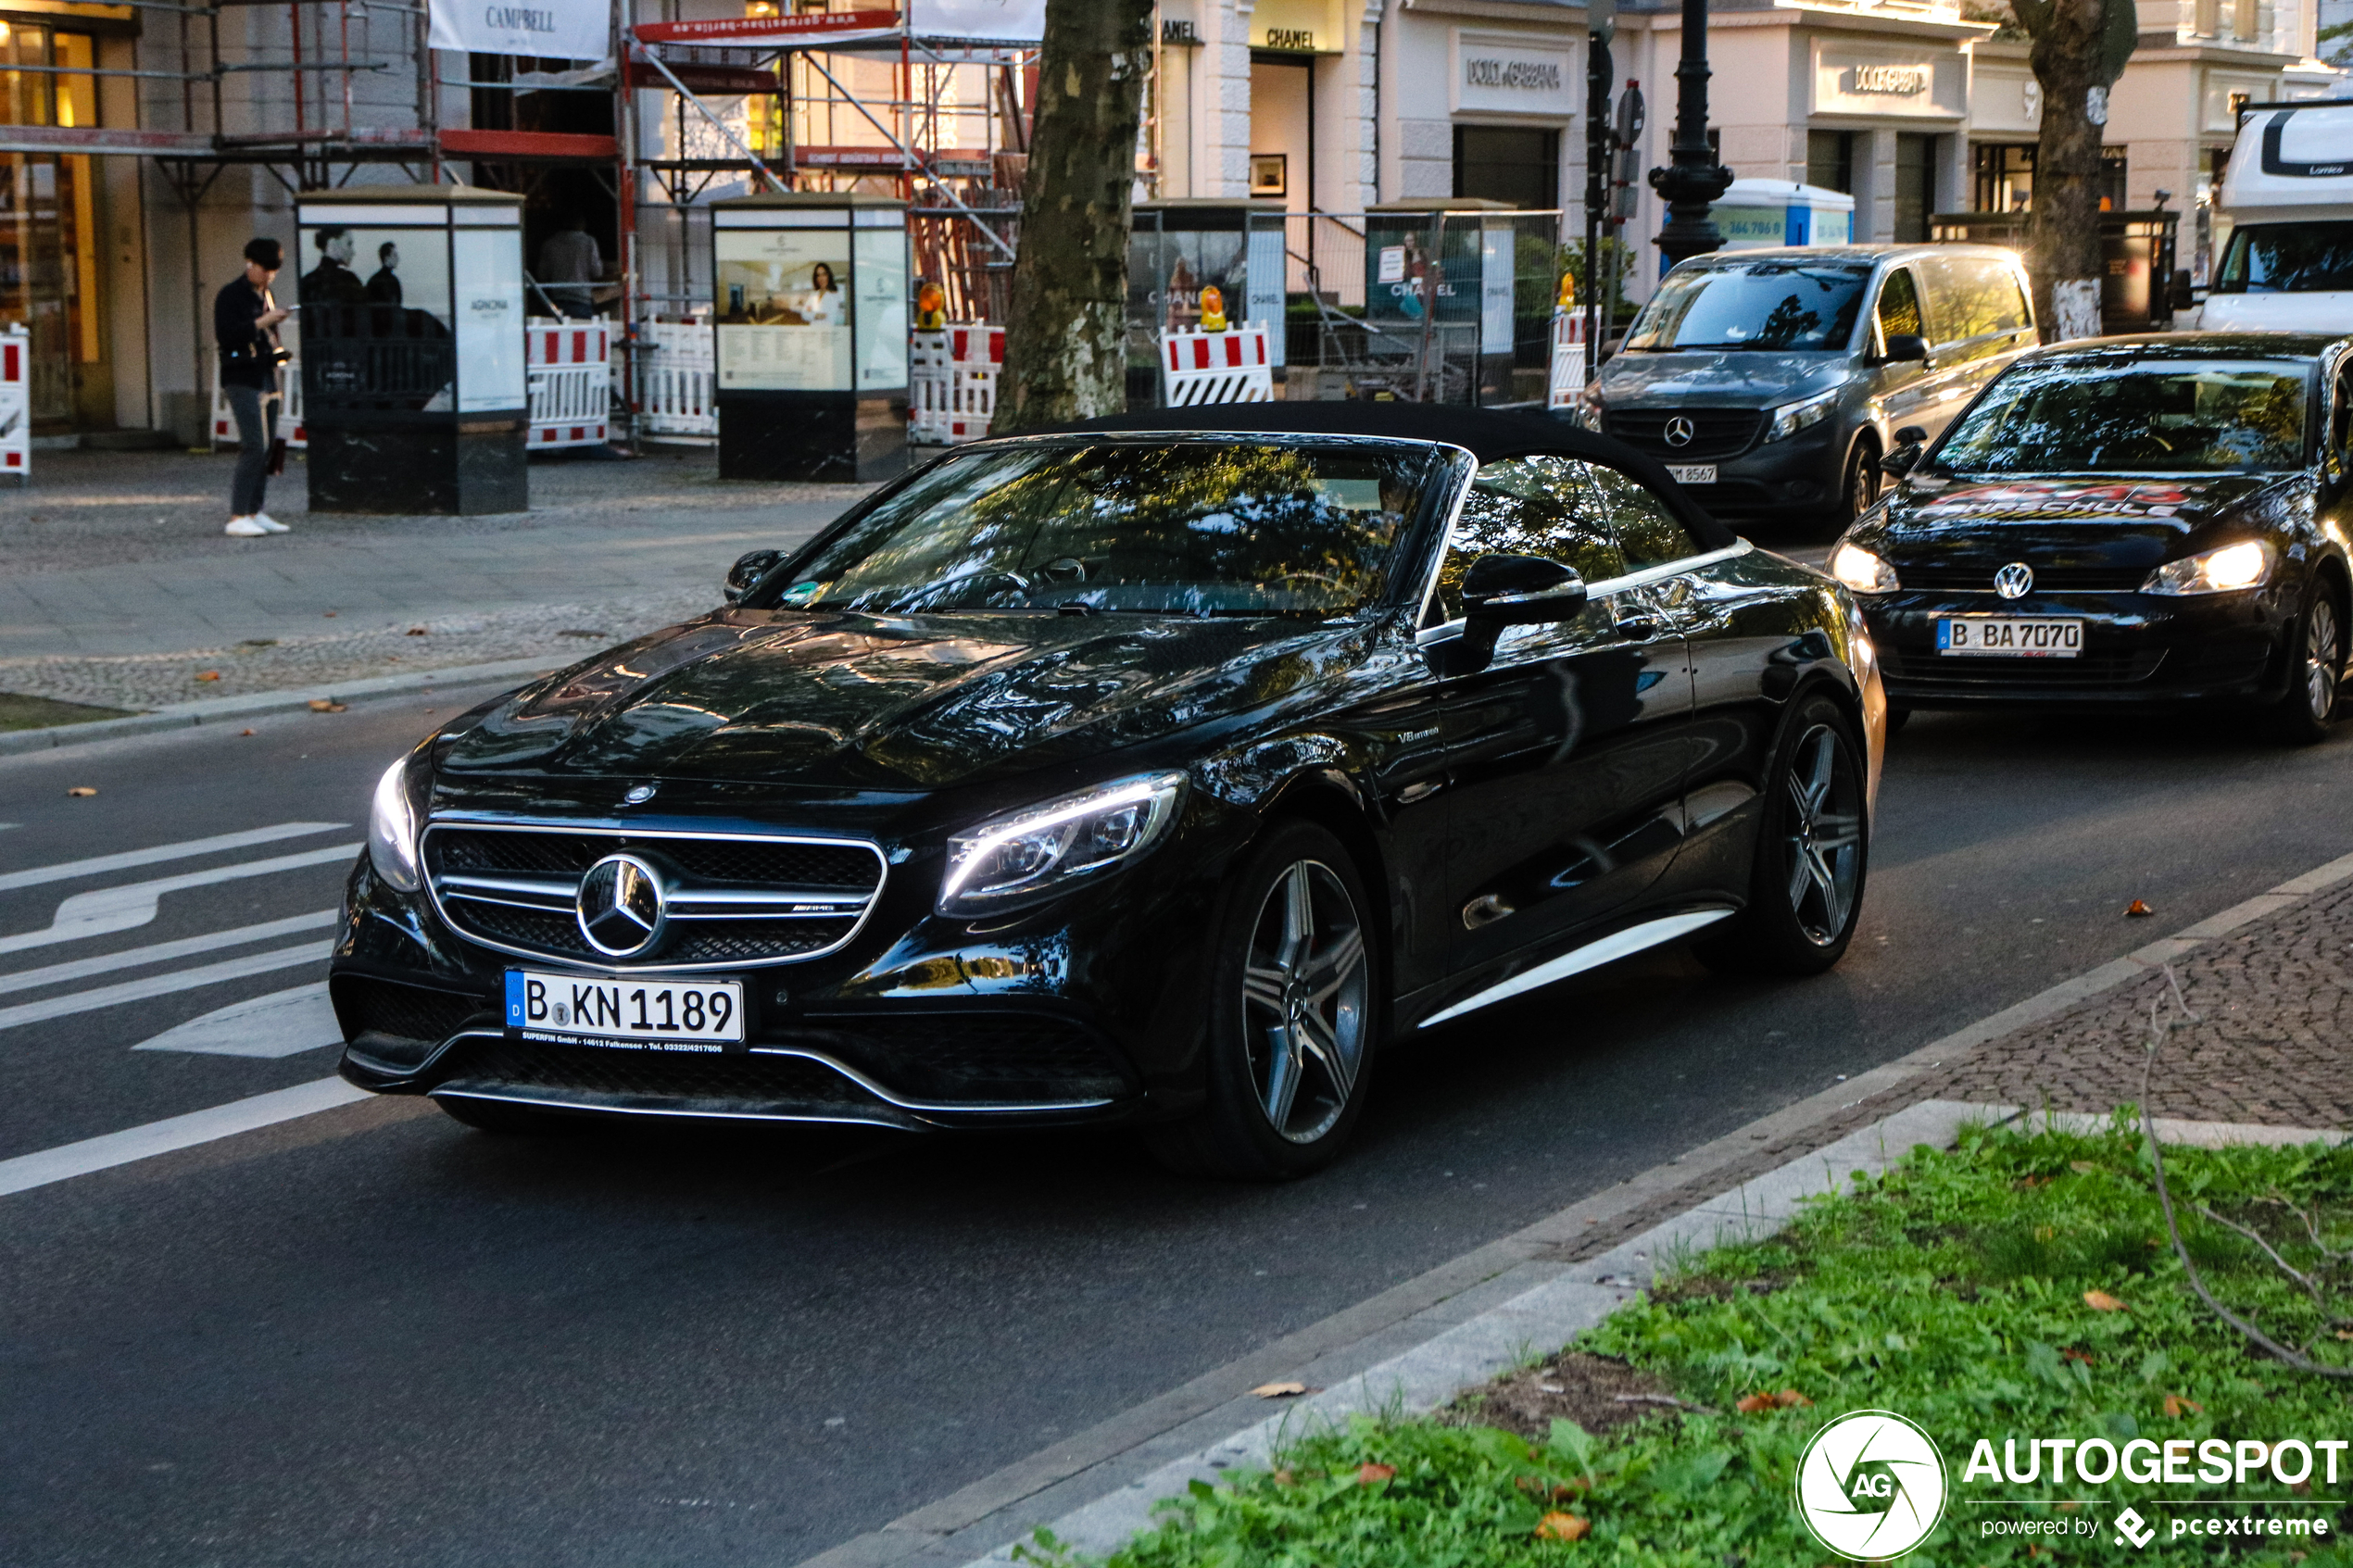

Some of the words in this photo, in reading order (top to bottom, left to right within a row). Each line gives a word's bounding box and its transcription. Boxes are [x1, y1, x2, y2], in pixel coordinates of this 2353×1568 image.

[485, 6, 556, 32] CAMPBELL
[1267, 28, 1315, 49] CHANEL
[1390, 283, 1457, 297] CHAEL
[1686, 468, 1715, 482] 8567
[1952, 623, 1968, 646] B
[512, 1004, 520, 1017] D
[527, 980, 548, 1022] B
[522, 1032, 556, 1043] SUPERFIN
[557, 1035, 577, 1045] GmbH
[605, 1040, 643, 1049] Falkensee
[648, 1043, 663, 1051] Tel.
